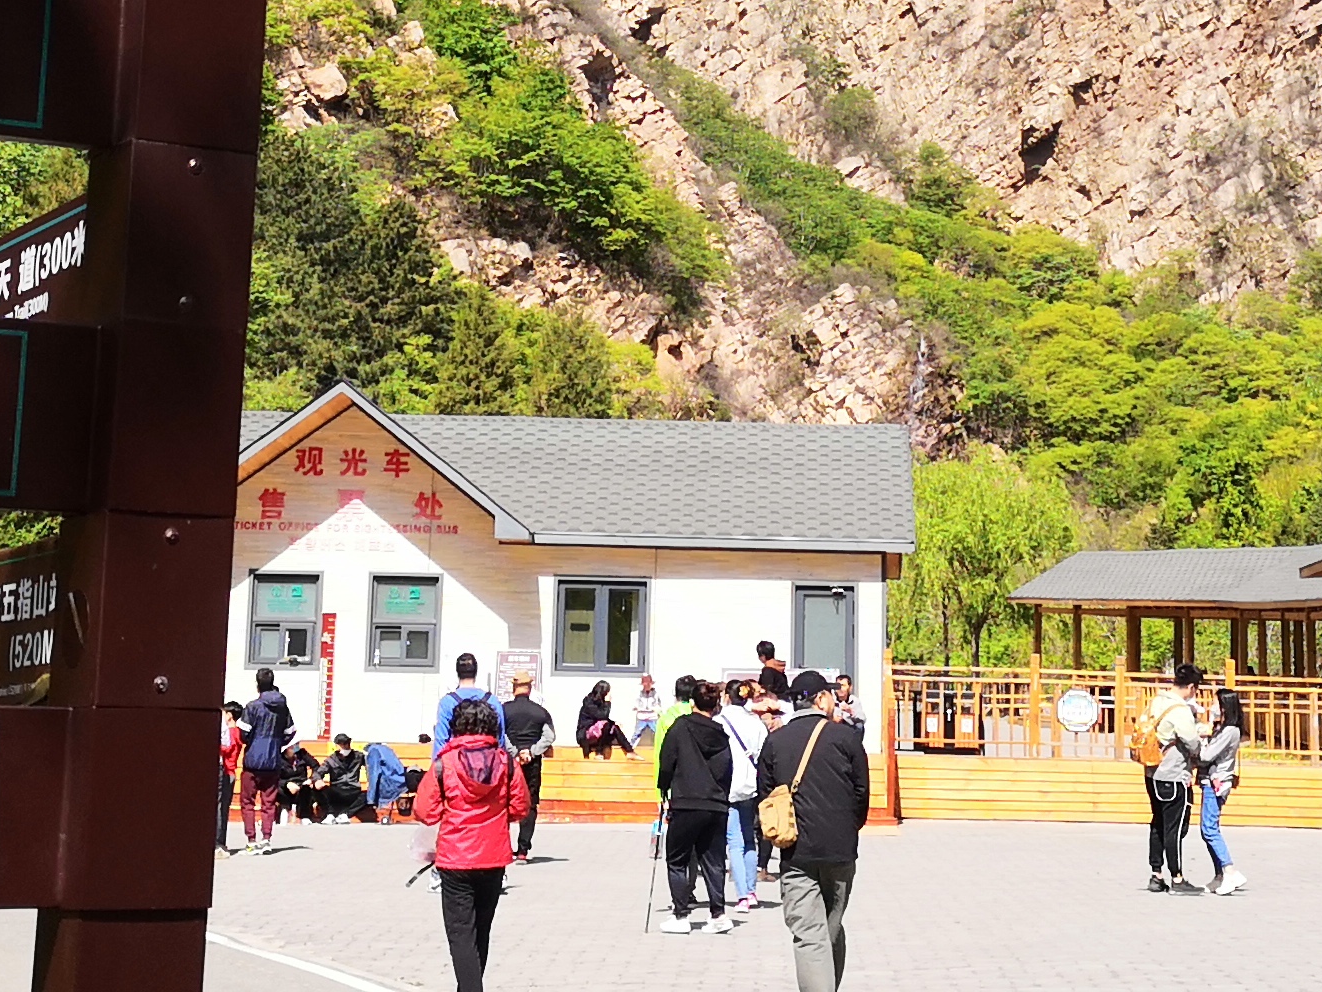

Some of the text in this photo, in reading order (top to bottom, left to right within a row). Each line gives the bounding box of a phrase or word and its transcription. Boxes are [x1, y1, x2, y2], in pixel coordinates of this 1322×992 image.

[294, 447, 411, 478] 观光车
[258, 488, 444, 521] 售票处
[234, 521, 273, 531] TICKET
[436, 524, 460, 535] BUS
